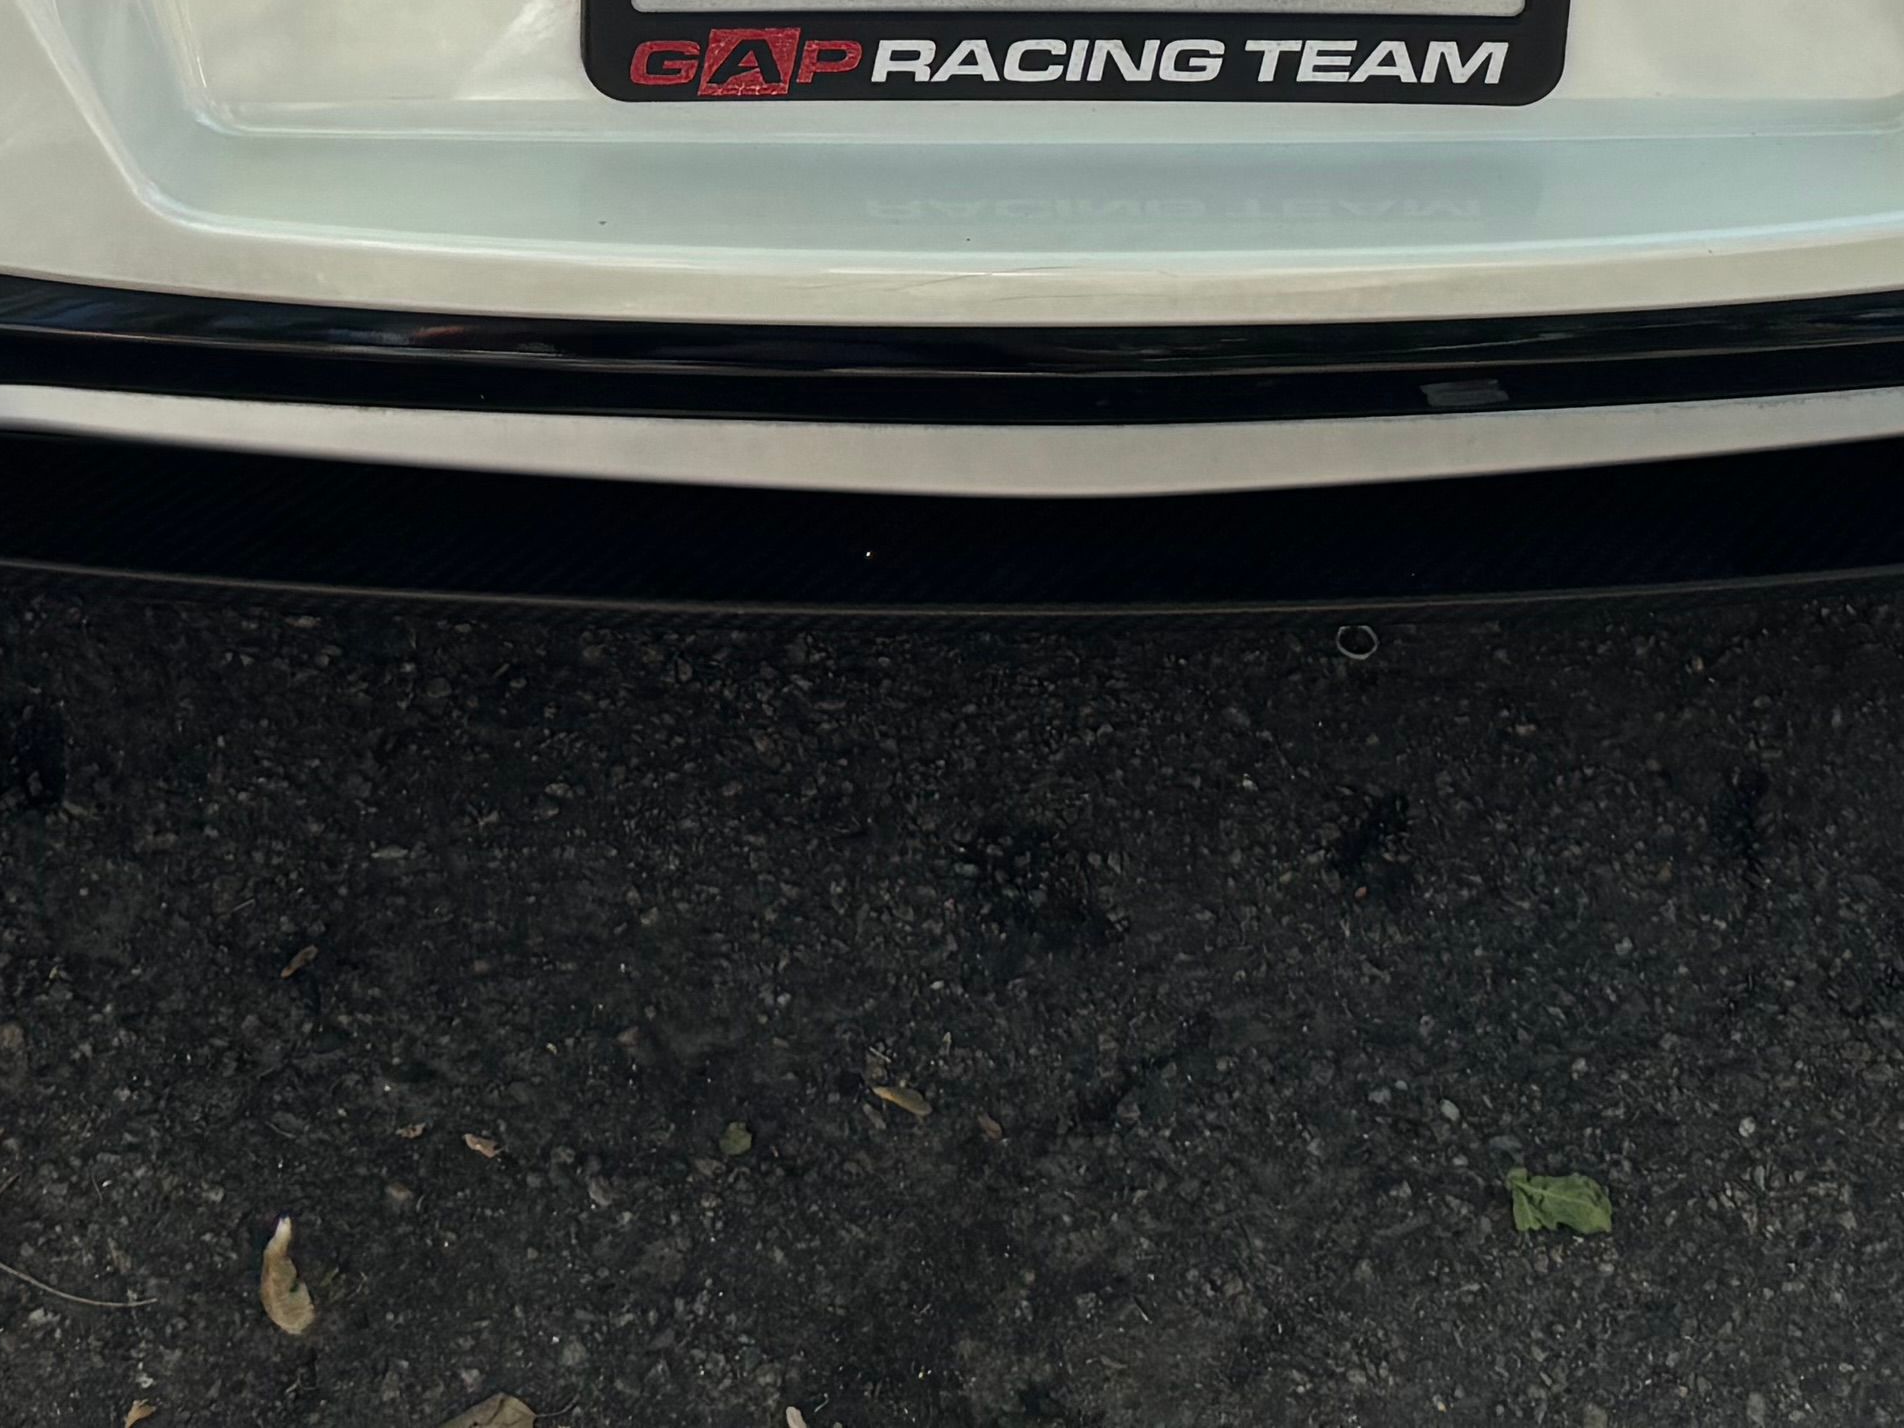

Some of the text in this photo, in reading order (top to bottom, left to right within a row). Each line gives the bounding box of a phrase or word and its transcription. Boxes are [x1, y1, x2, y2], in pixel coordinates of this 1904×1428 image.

[629, 34, 1509, 89] GAP RACING TEAM
